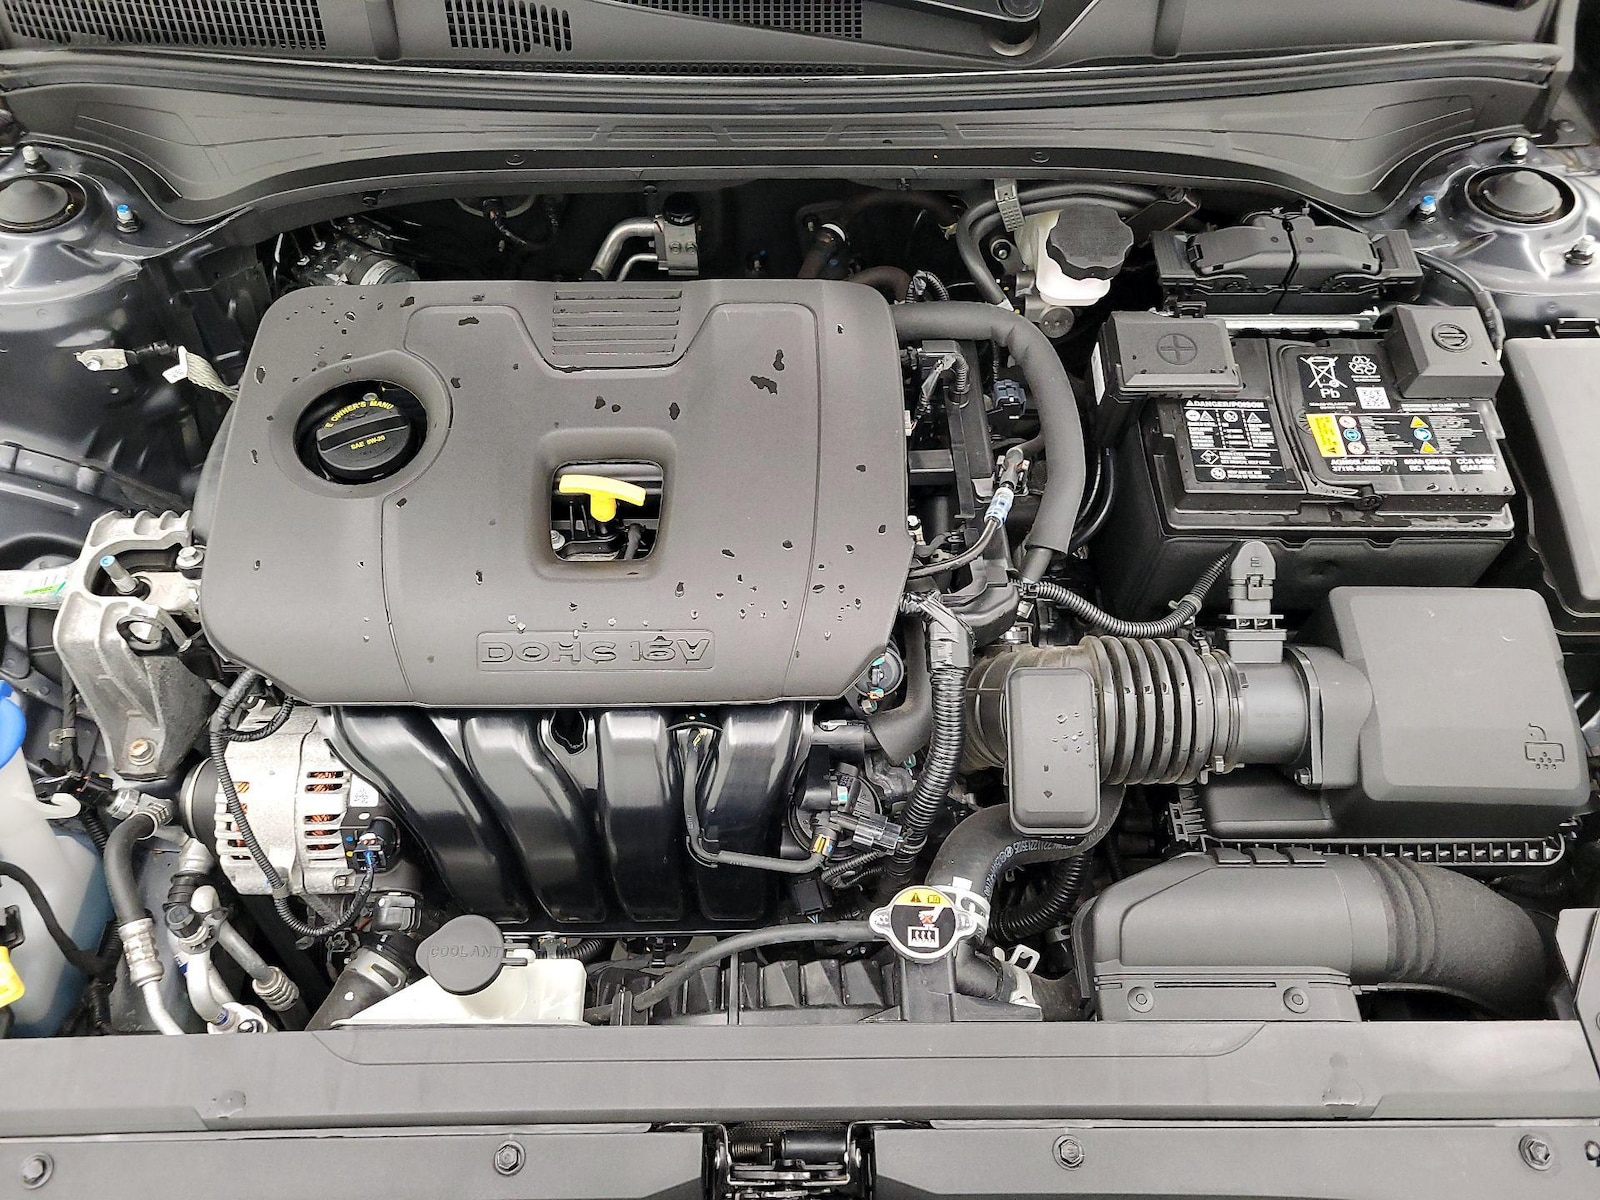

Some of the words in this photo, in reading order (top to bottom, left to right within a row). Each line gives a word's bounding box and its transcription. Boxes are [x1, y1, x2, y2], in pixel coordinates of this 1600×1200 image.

[1320, 388, 1340, 398] Pb
[331, 401, 367, 421] OWNER'S
[369, 401, 394, 410] MANU
[482, 640, 617, 663] DOHC
[630, 638, 710, 663] 16V
[431, 945, 503, 959] COOLANT
